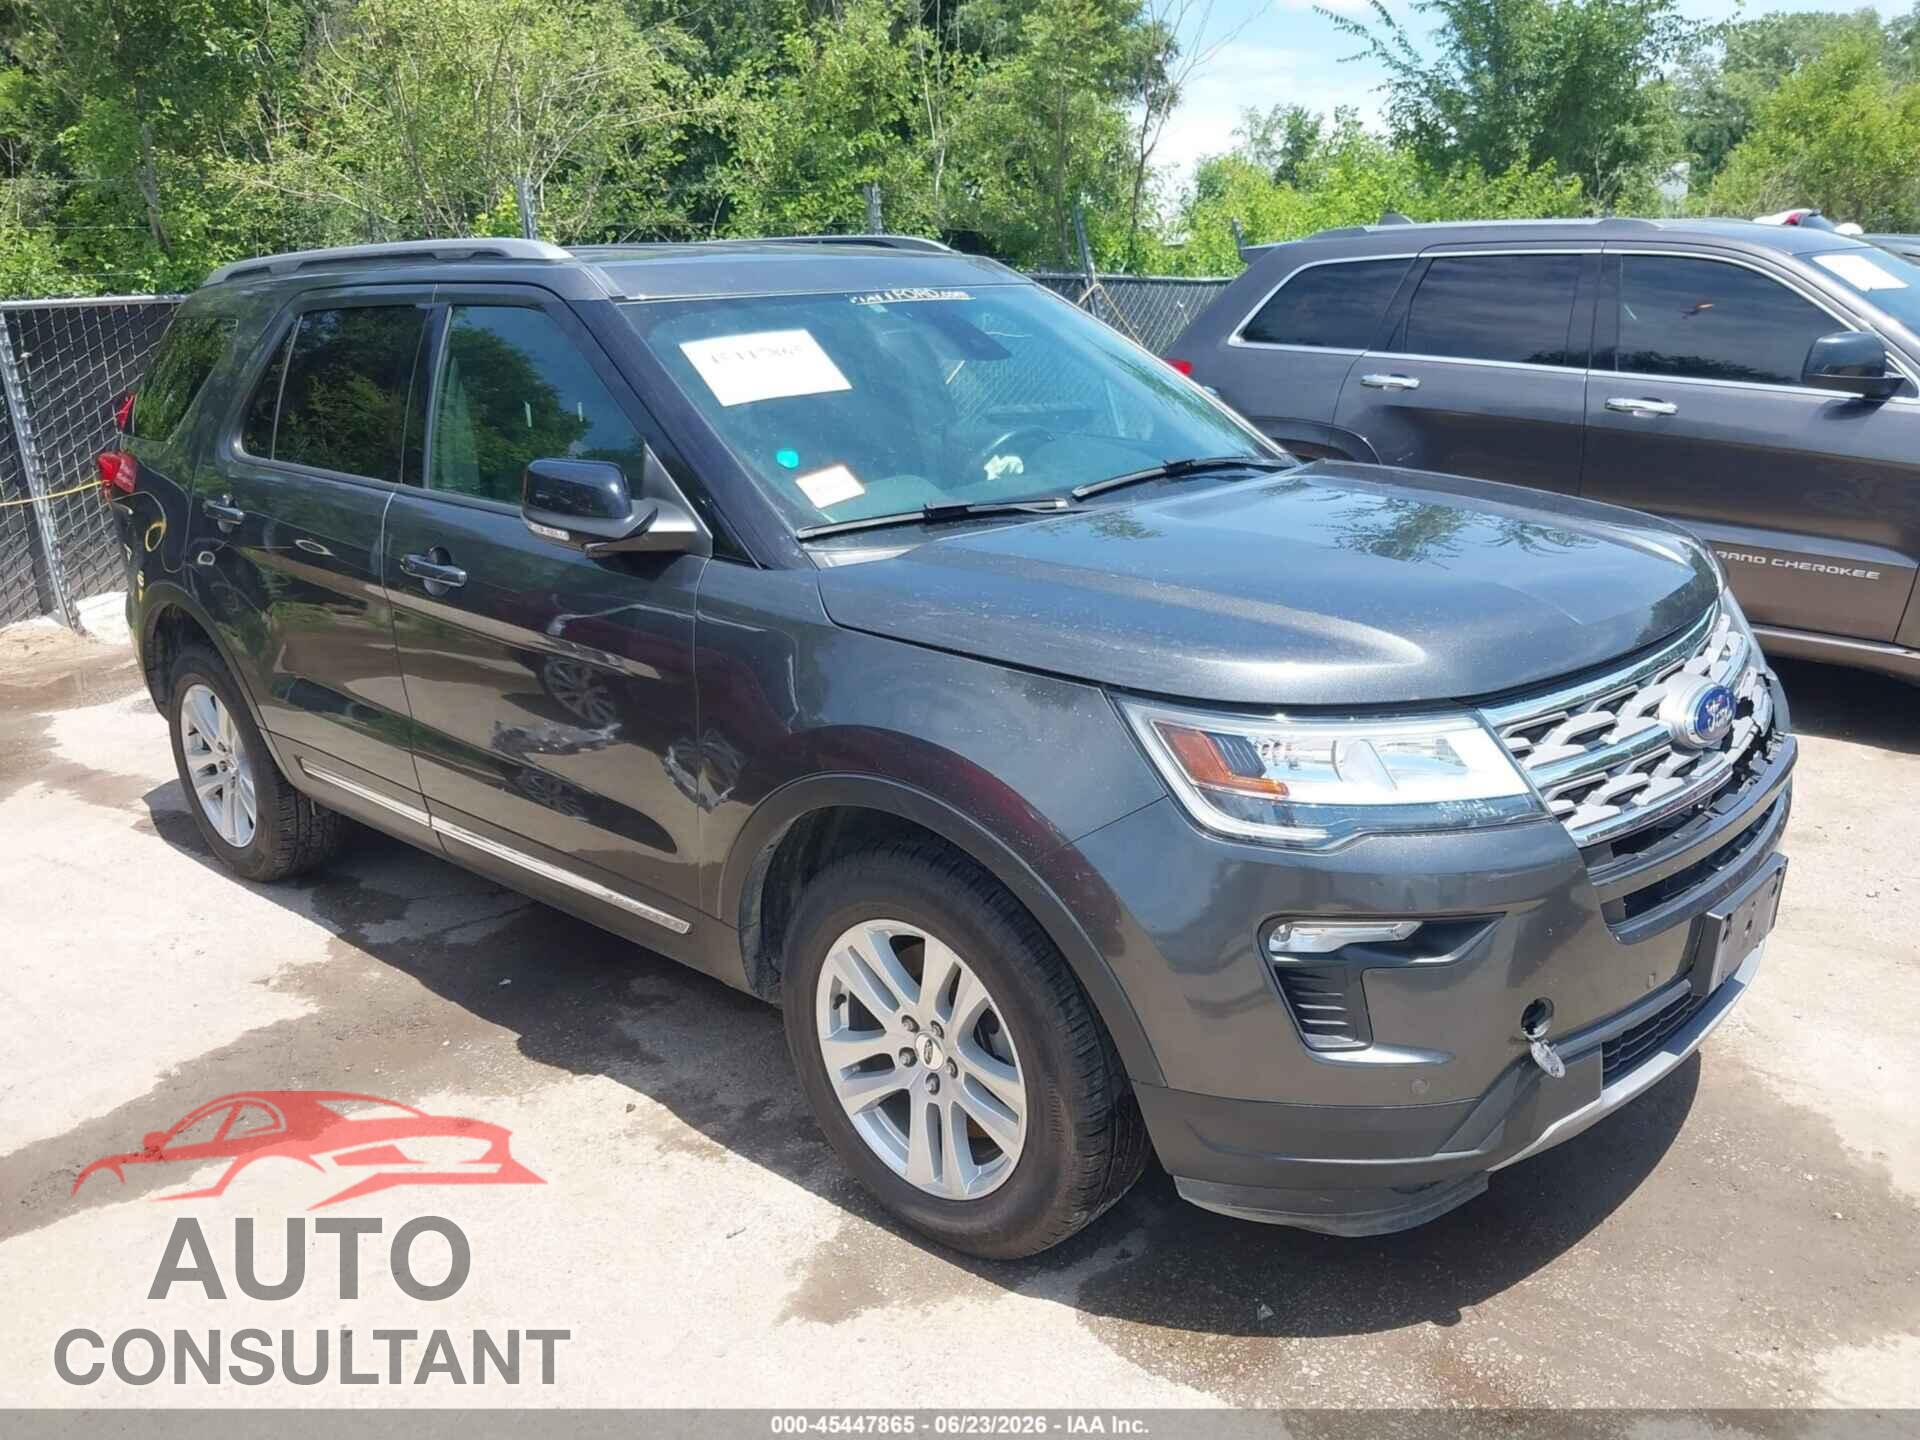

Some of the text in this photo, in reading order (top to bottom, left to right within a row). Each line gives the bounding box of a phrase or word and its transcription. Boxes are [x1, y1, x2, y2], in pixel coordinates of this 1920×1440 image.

[1715, 550, 1881, 580] RAND CHEROKEE
[1704, 694, 1733, 733] Ford
